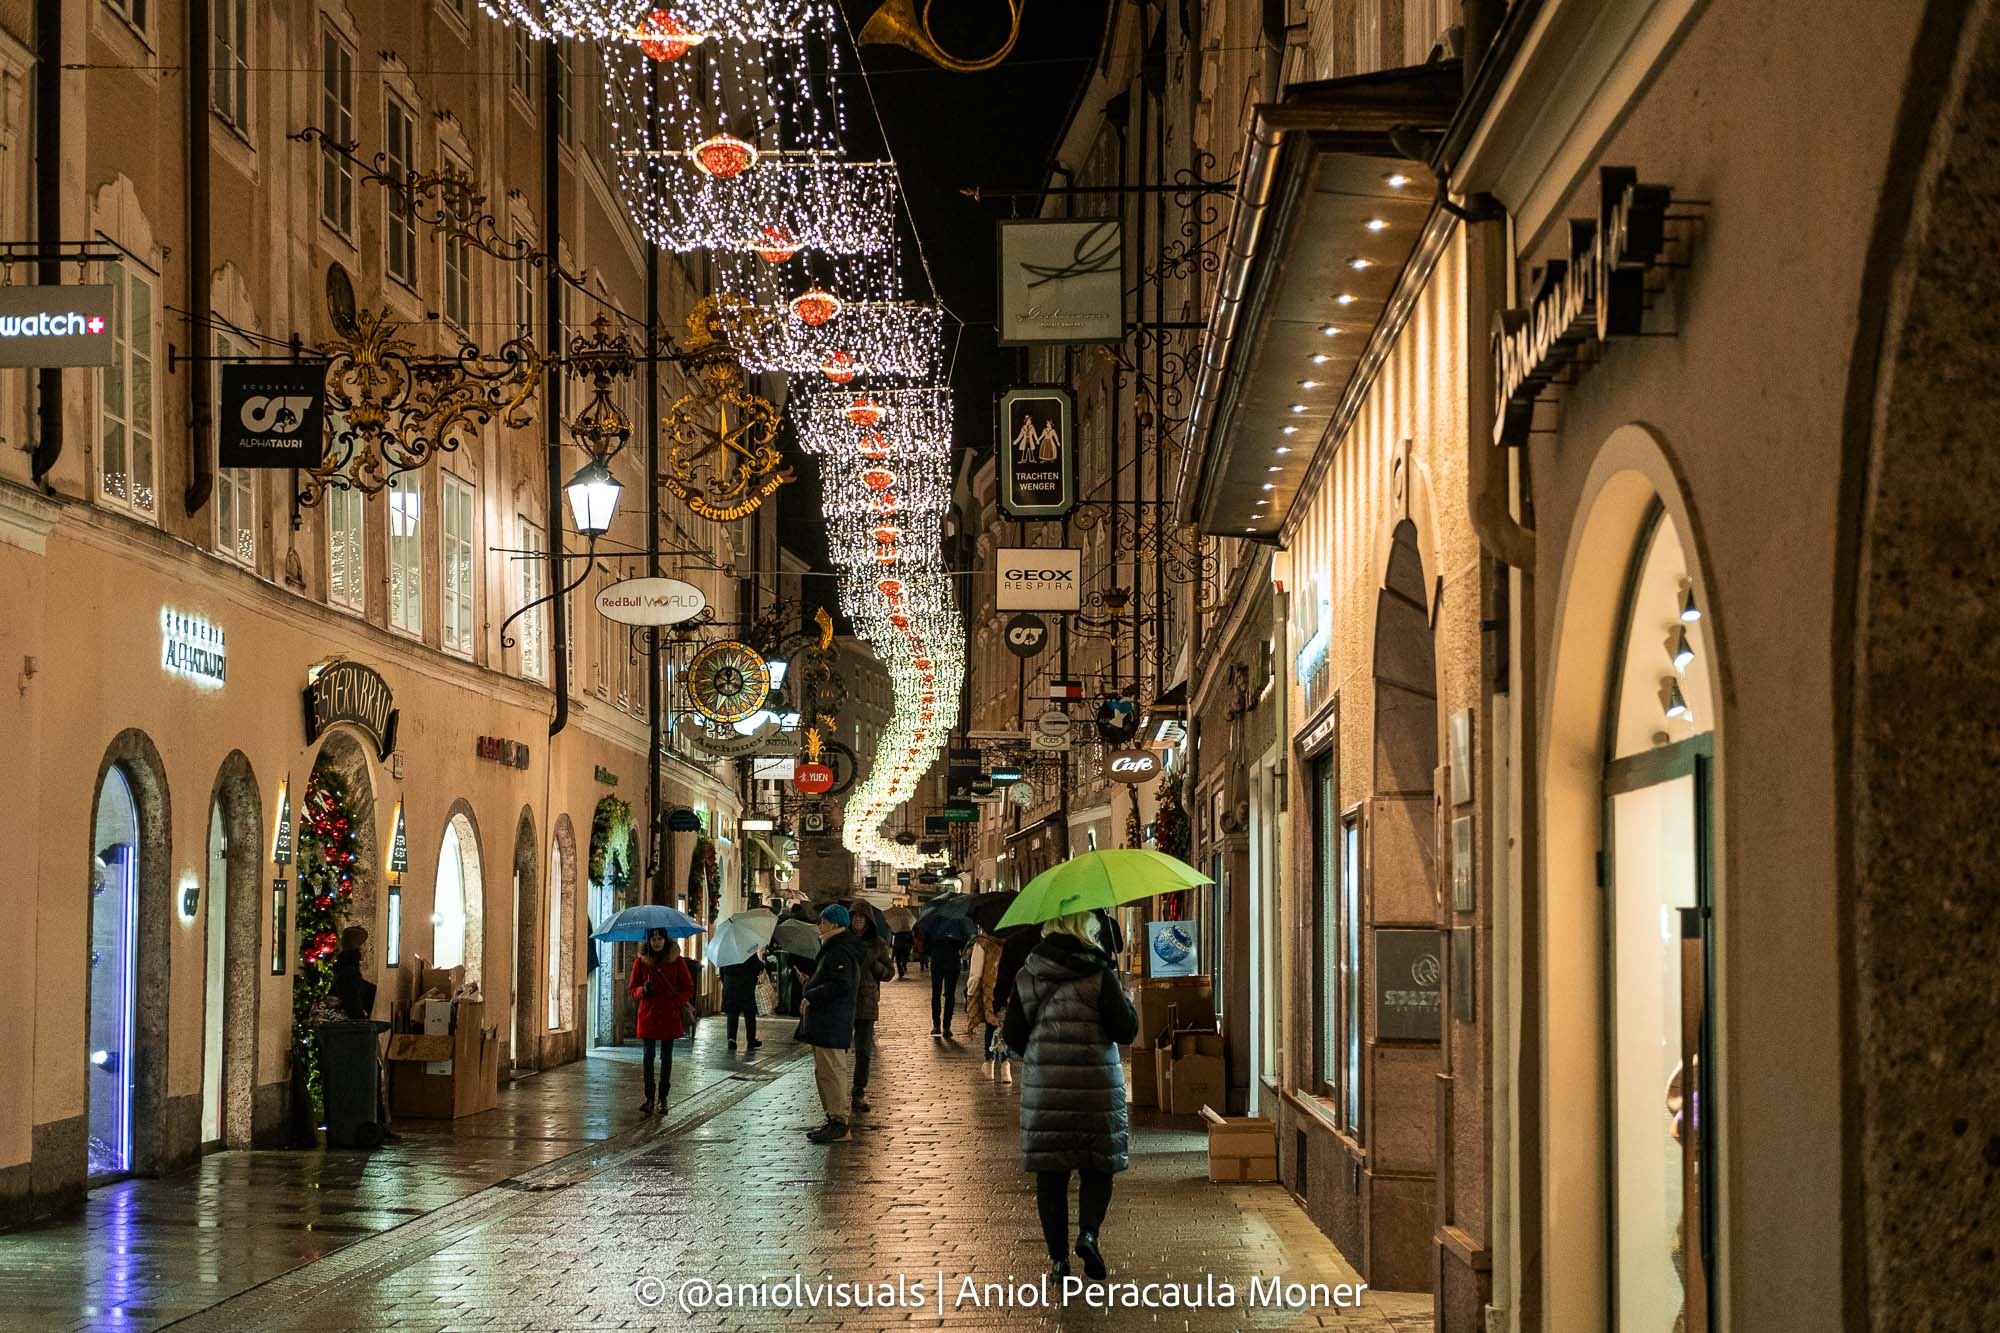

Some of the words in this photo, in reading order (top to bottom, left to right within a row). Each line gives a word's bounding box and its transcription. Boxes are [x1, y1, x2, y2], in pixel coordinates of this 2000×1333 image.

[239, 438, 303, 449] ALPHATAURI
[1015, 472, 1060, 481] TRACHTEN
[1019, 482, 1056, 491] WENGER
[665, 479, 687, 499] 1720
[689, 496, 762, 521] Sternbräu
[1005, 569, 1073, 581] GEOX
[1004, 581, 1073, 591] RESPIRA
[602, 597, 621, 607] Red
[622, 596, 641, 607] Bull
[165, 639, 227, 682] ALPHATAURI
[694, 735, 765, 753] Aschauer
[809, 772, 829, 783] YUEN
